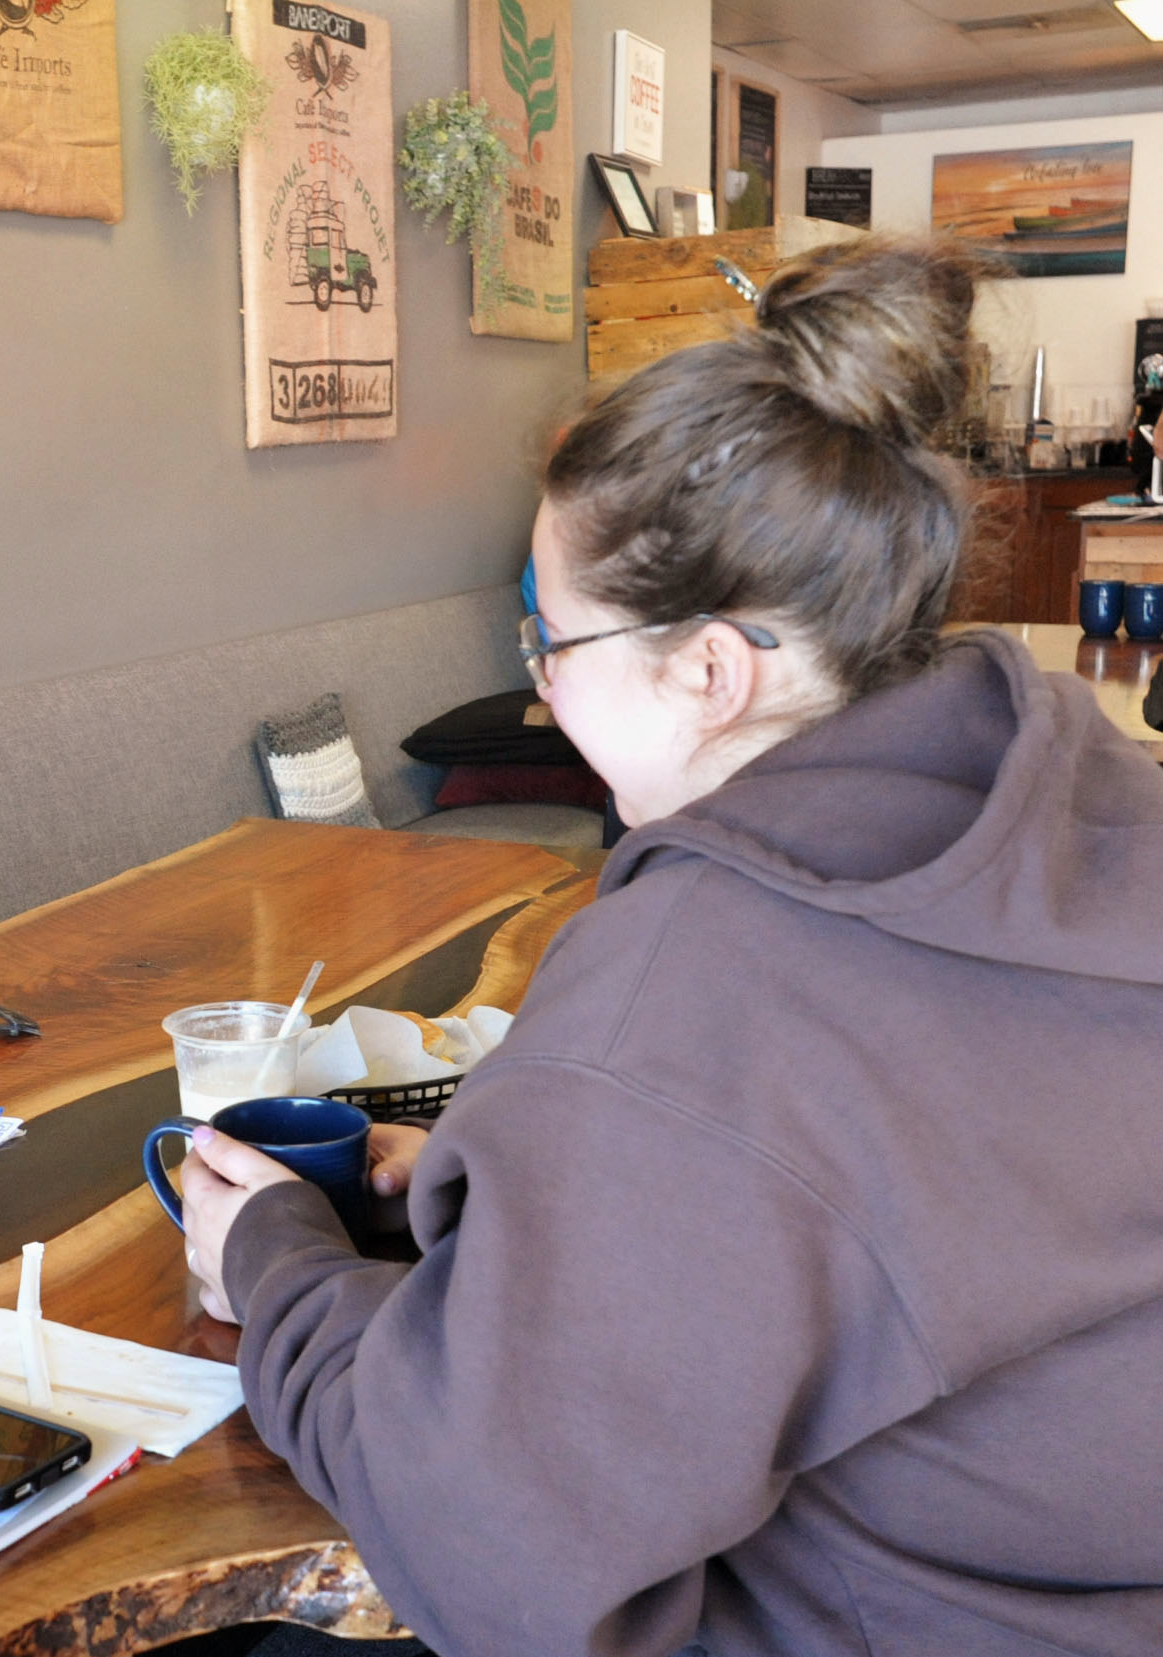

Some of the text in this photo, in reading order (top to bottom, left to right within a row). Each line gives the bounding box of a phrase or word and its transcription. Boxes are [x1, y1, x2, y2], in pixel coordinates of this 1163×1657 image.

[289, 5, 351, 40] BANEXPORT
[13, 47, 72, 80] Imports
[630, 73, 661, 115] COFFEE
[544, 195, 560, 220] DO
[278, 374, 290, 410] 3
[298, 372, 337, 409] 268
